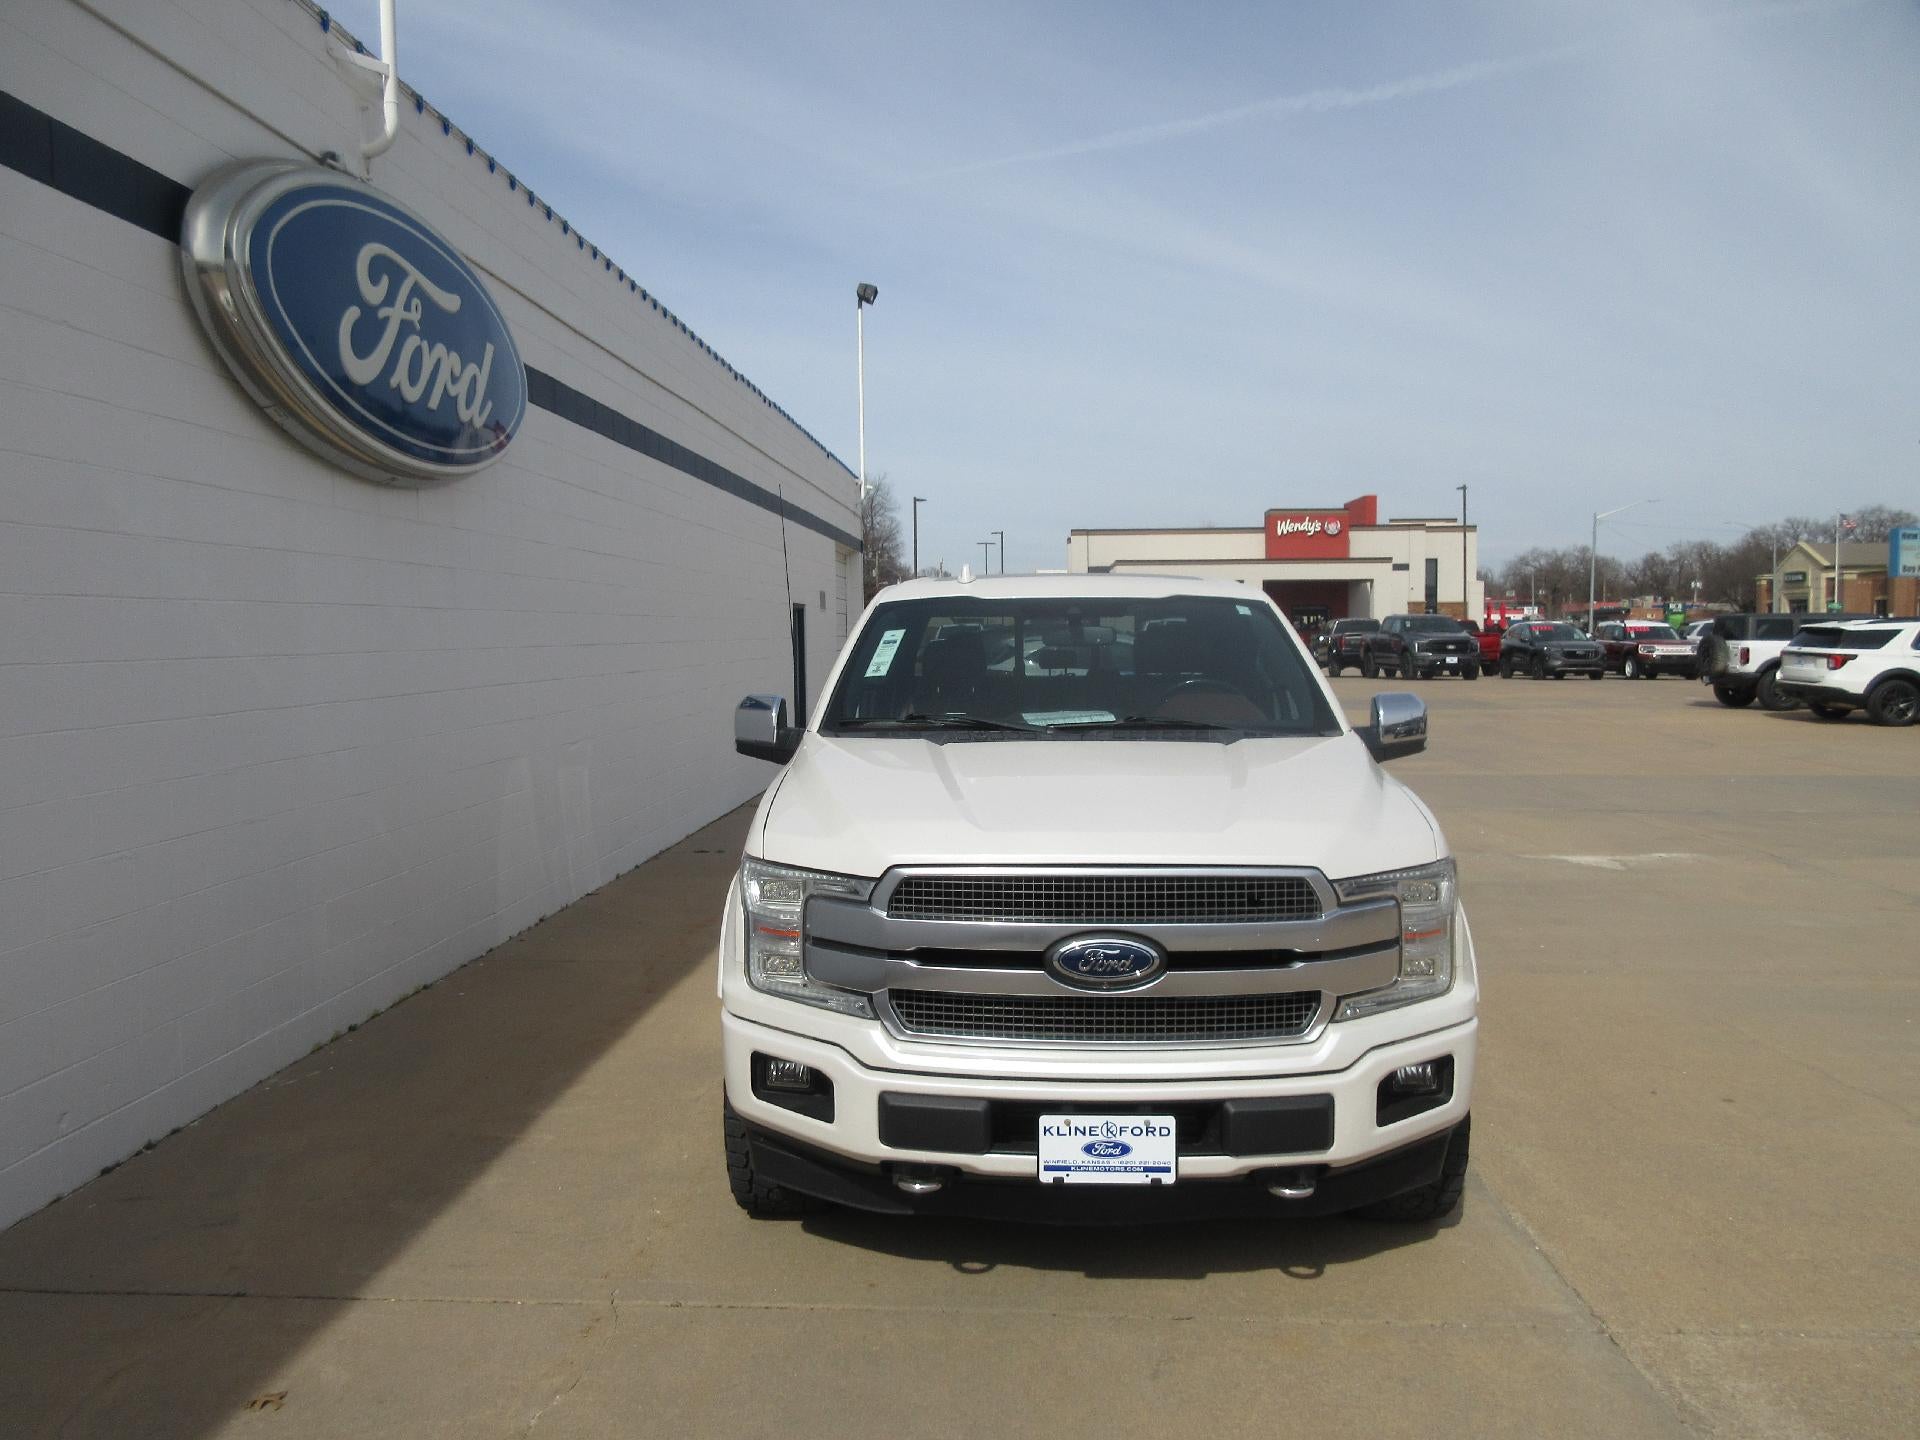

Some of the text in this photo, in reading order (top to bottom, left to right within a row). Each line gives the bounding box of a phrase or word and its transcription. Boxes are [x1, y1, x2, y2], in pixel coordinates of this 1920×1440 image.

[338, 242, 494, 429] Ford
[1277, 516, 1322, 536] Wendy's
[1078, 948, 1135, 972] Ford
[1043, 1126, 1099, 1137] KLINE
[1119, 1126, 1171, 1137] FORD
[1091, 1141, 1122, 1155] Ford
